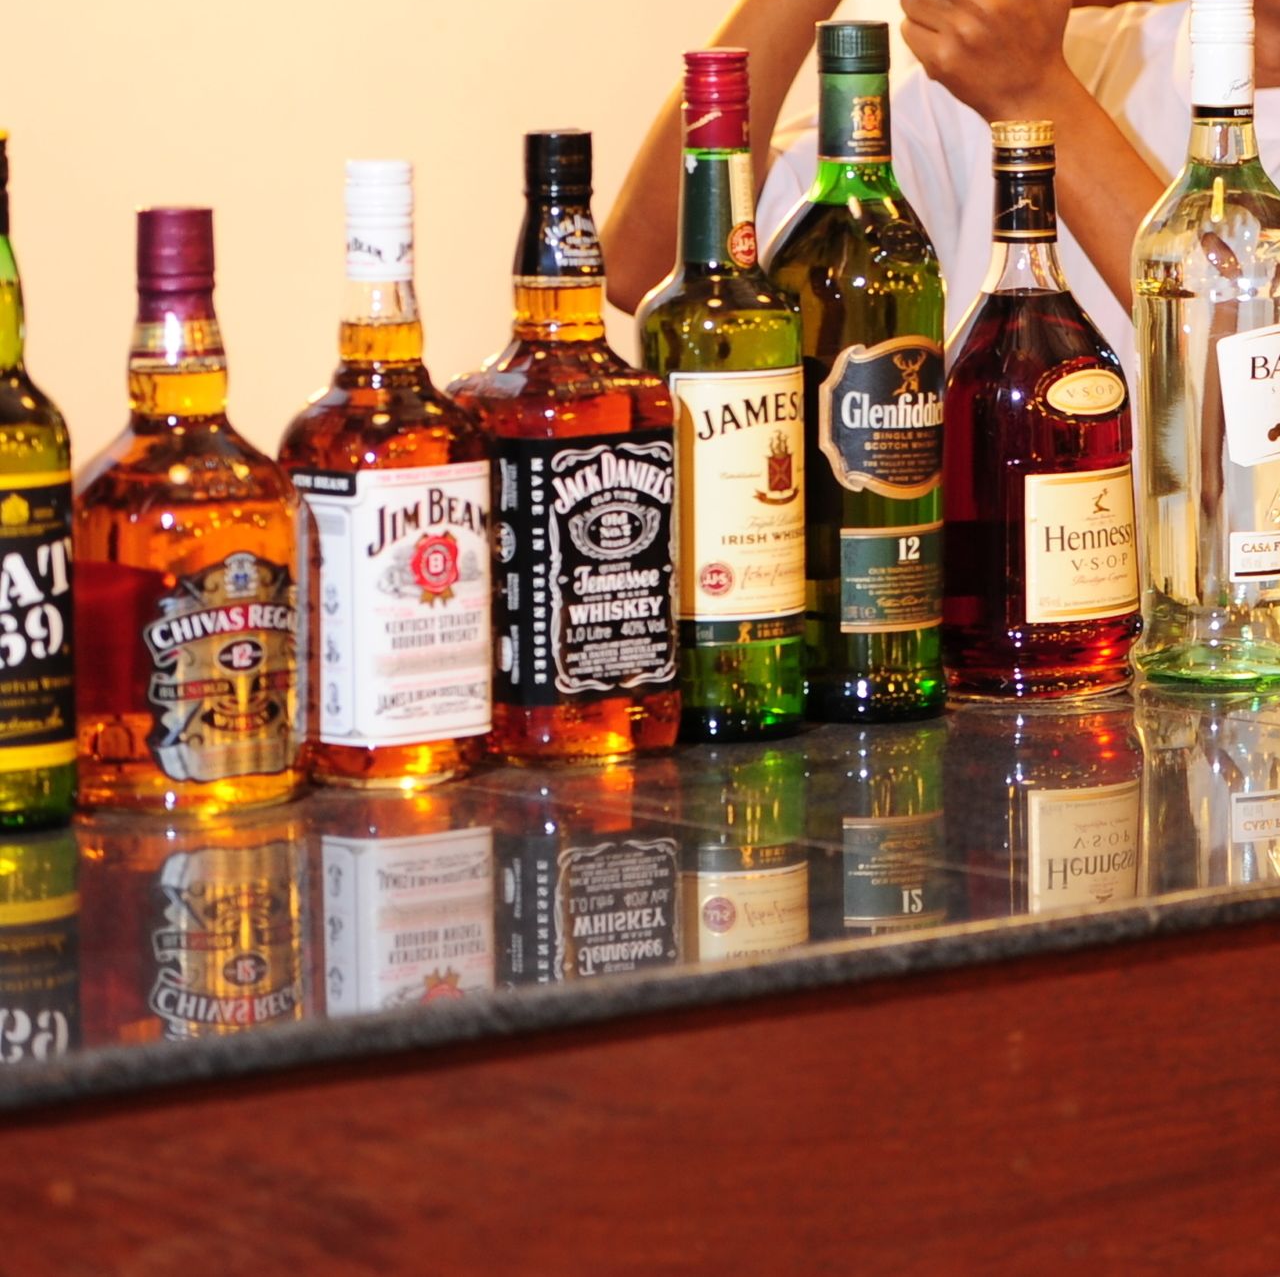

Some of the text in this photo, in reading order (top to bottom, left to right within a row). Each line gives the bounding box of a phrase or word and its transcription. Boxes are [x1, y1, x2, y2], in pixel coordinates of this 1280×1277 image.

[698, 390, 804, 441] JAMES
[864, 441, 908, 451] SCOTCH
[872, 431, 914, 441] SINGLE
[552, 462, 598, 514] JACK
[600, 451, 673, 505] DANIEL'S
[367, 501, 421, 558] JIM
[721, 533, 767, 547] IRISH
[898, 535, 920, 562] 12
[1241, 541, 1271, 554] CASA
[530, 457, 548, 685] MADE IN TENNESSEE
[573, 565, 660, 596] Tennessee
[385, 611, 482, 635] KENTUCKY STRAIGHT
[568, 596, 663, 626] WHISKEY
[151, 605, 245, 651] CHIVAS
[392, 627, 479, 651] BOURBON WHISKEY
[587, 624, 613, 640] Litre
[620, 621, 646, 637] 40%
[231, 643, 253, 668] 12
